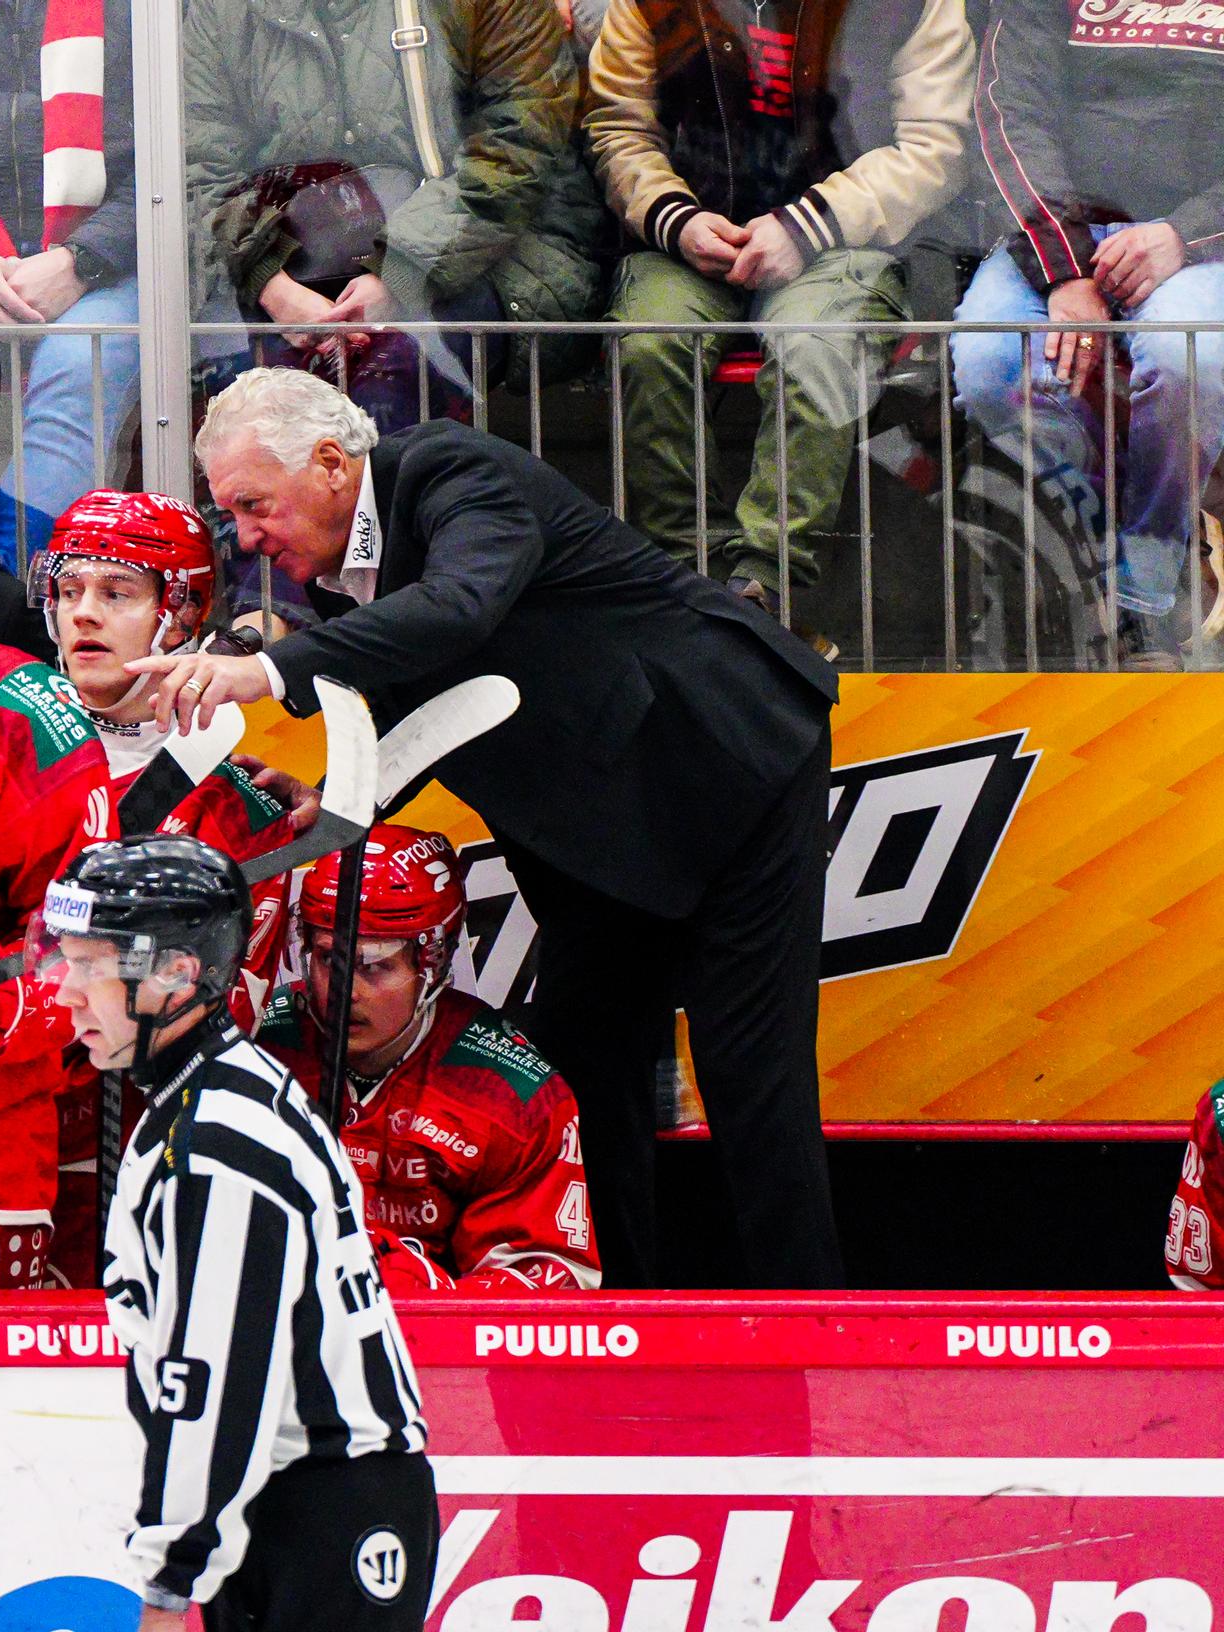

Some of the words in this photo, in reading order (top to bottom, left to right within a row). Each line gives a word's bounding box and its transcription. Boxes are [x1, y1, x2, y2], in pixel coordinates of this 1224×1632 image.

[1076, 24, 1153, 37] MOTOR
[410, 1114, 479, 1158] Wapice
[555, 1180, 590, 1250] 4
[1164, 1194, 1213, 1276] 33
[475, 1325, 639, 1358] PUUILO
[947, 1325, 1111, 1358] PUUILO
[160, 1361, 189, 1413] 5
